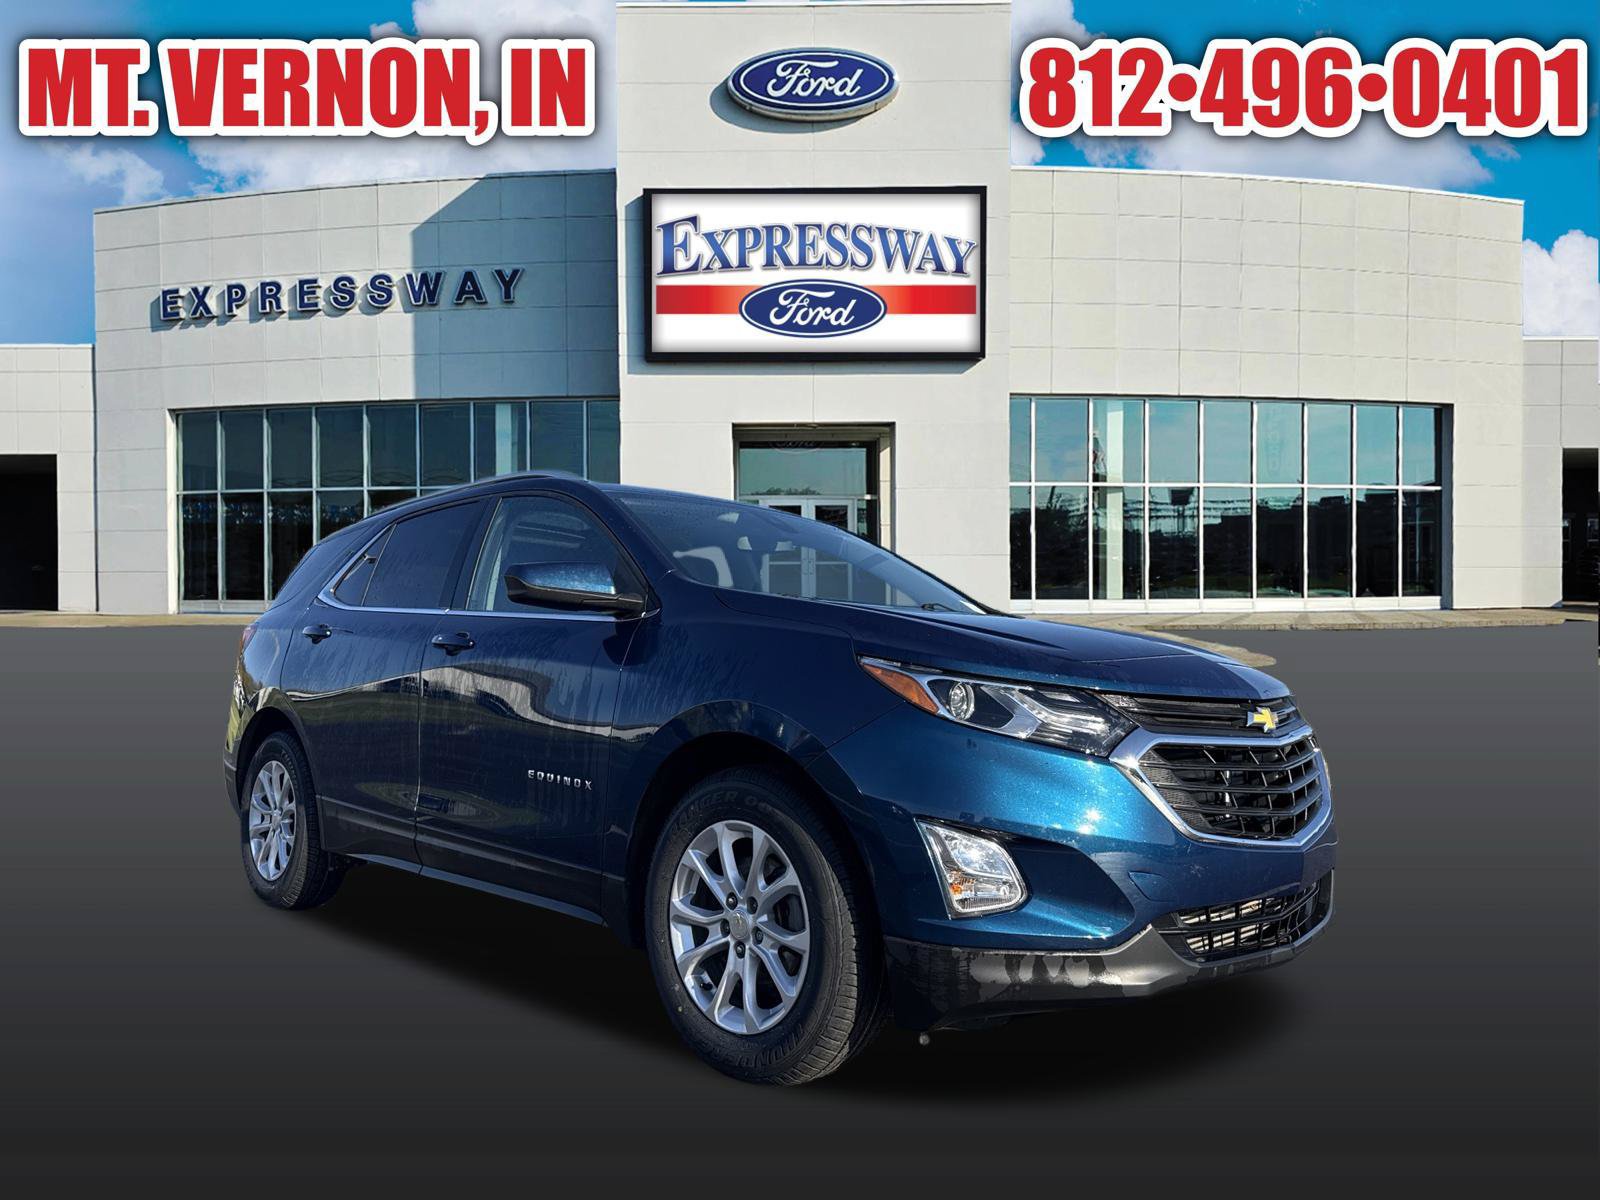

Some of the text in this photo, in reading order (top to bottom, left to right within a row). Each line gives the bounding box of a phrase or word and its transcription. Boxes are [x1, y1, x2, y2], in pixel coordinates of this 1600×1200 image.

[766, 59, 864, 97] Ford
[160, 268, 525, 321] EXPRESSWAY
[769, 288, 855, 326] Ford
[527, 769, 592, 791] EQUINOX
